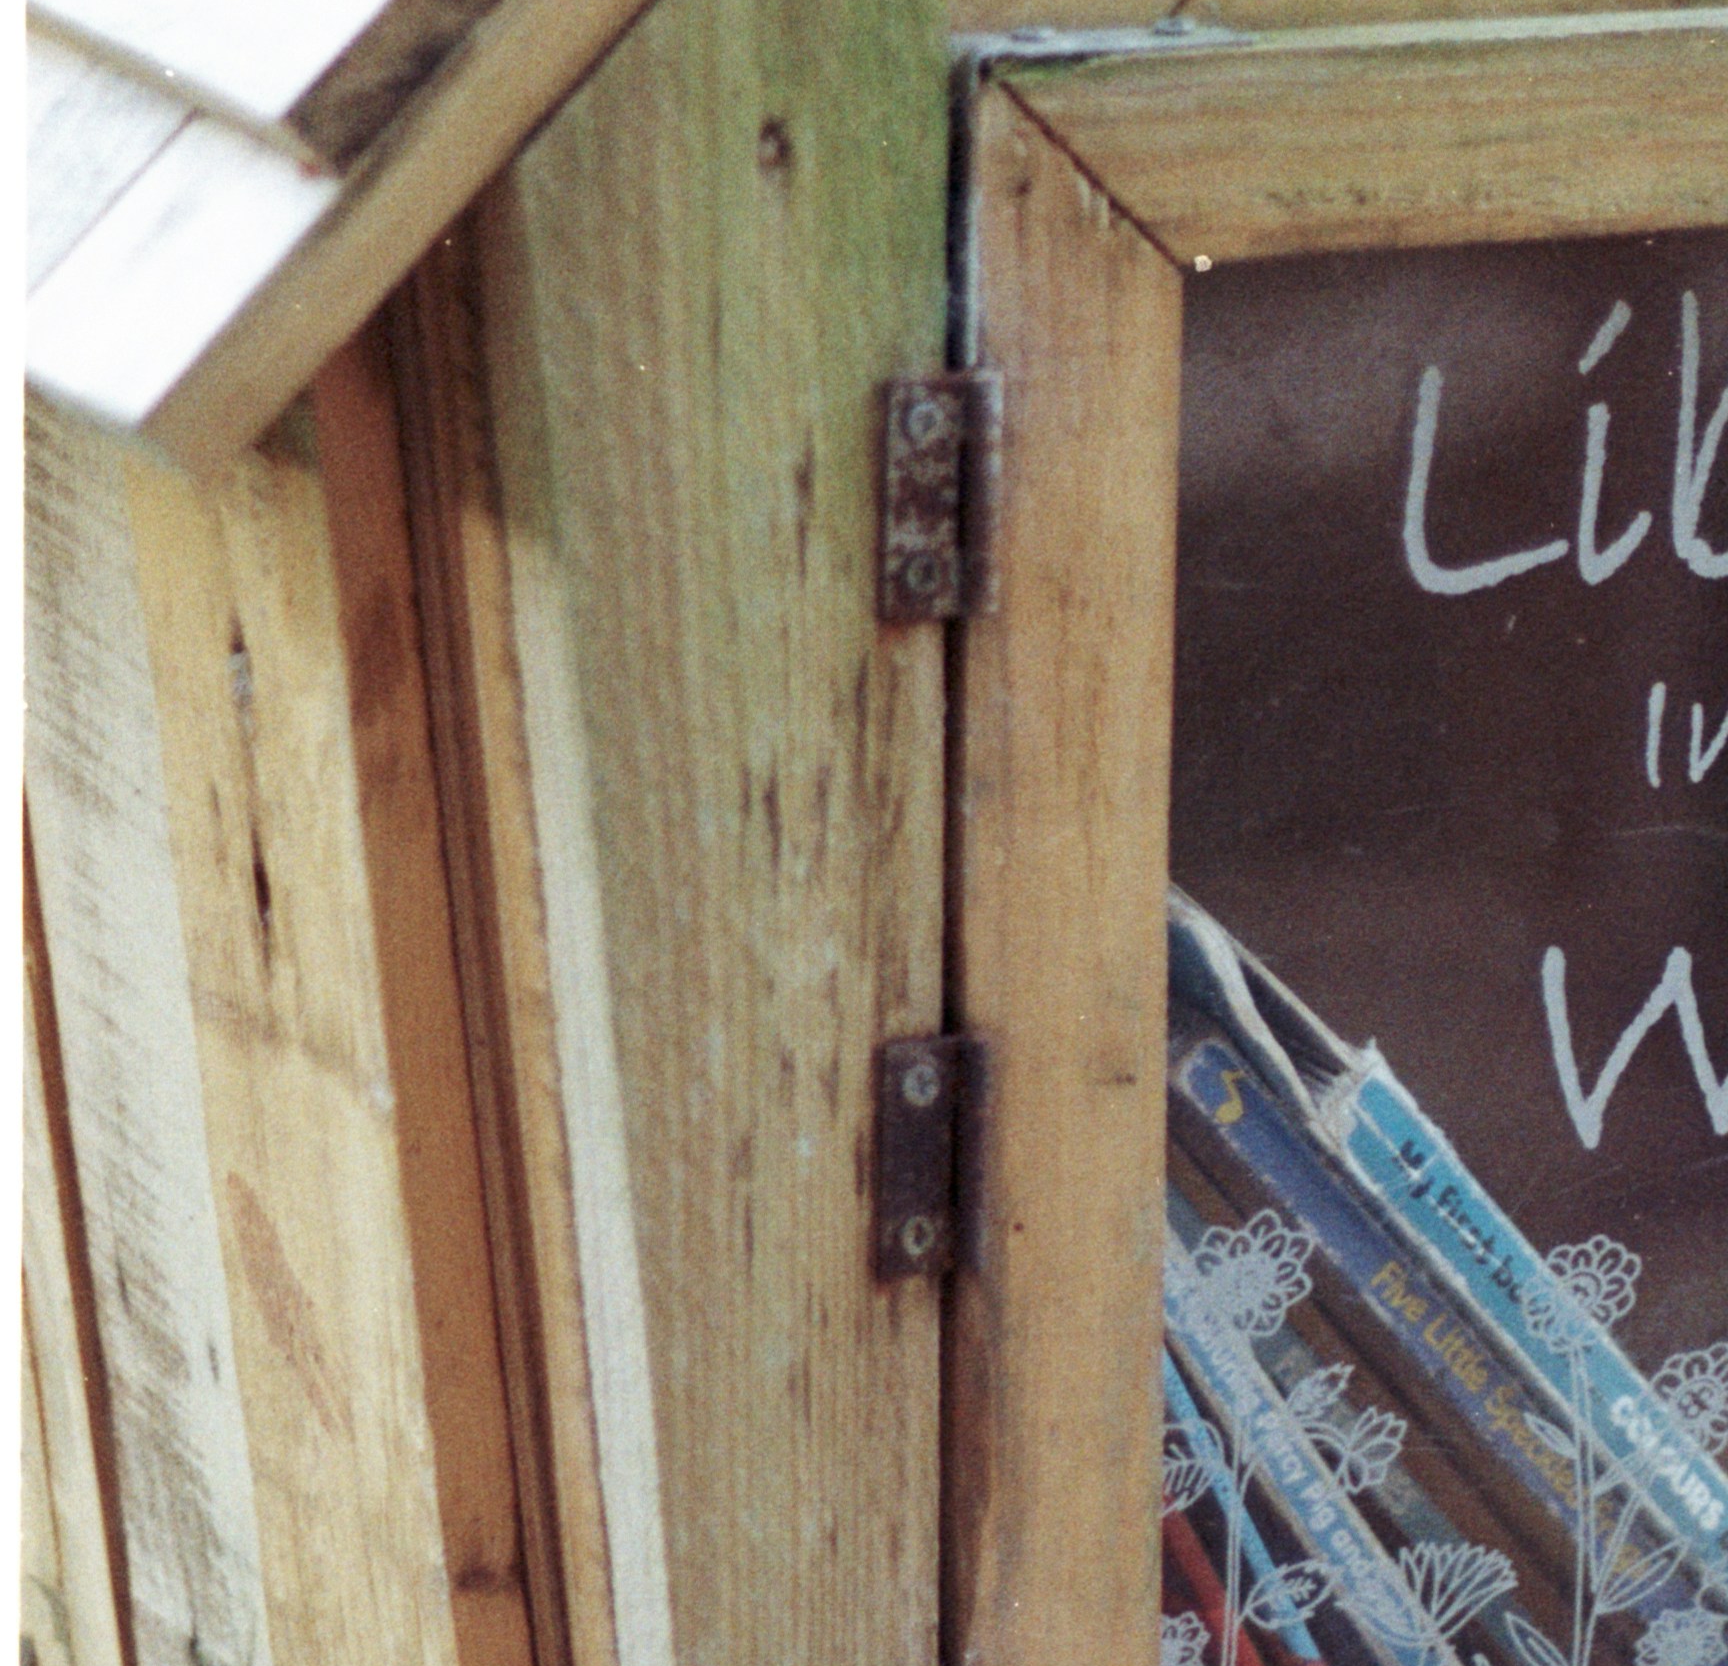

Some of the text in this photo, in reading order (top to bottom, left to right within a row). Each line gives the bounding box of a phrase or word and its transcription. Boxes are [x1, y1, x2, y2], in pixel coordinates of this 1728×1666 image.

[1370, 1260, 1431, 1325] Five
[1422, 1312, 1493, 1394] Little
[1299, 1482, 1340, 1532] Pig
